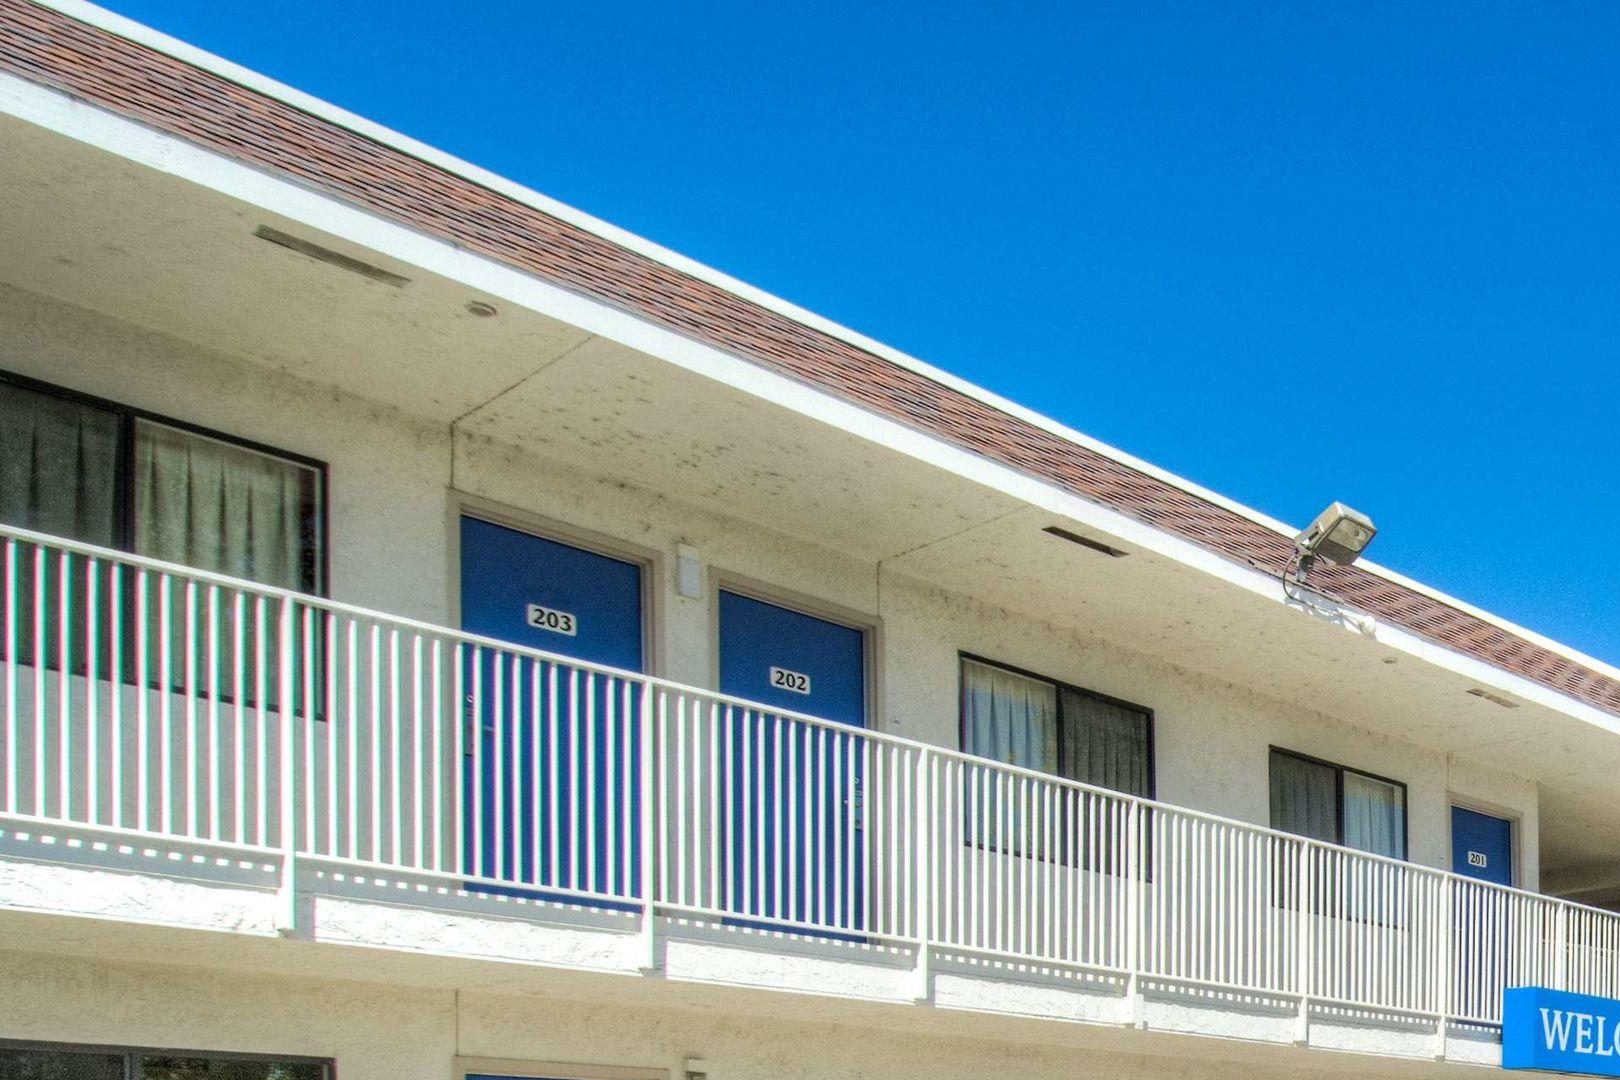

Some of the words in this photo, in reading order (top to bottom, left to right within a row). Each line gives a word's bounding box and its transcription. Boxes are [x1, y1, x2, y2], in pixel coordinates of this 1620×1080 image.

[533, 608, 572, 632] 203
[774, 670, 807, 691] 202
[1470, 853, 1485, 866] 201
